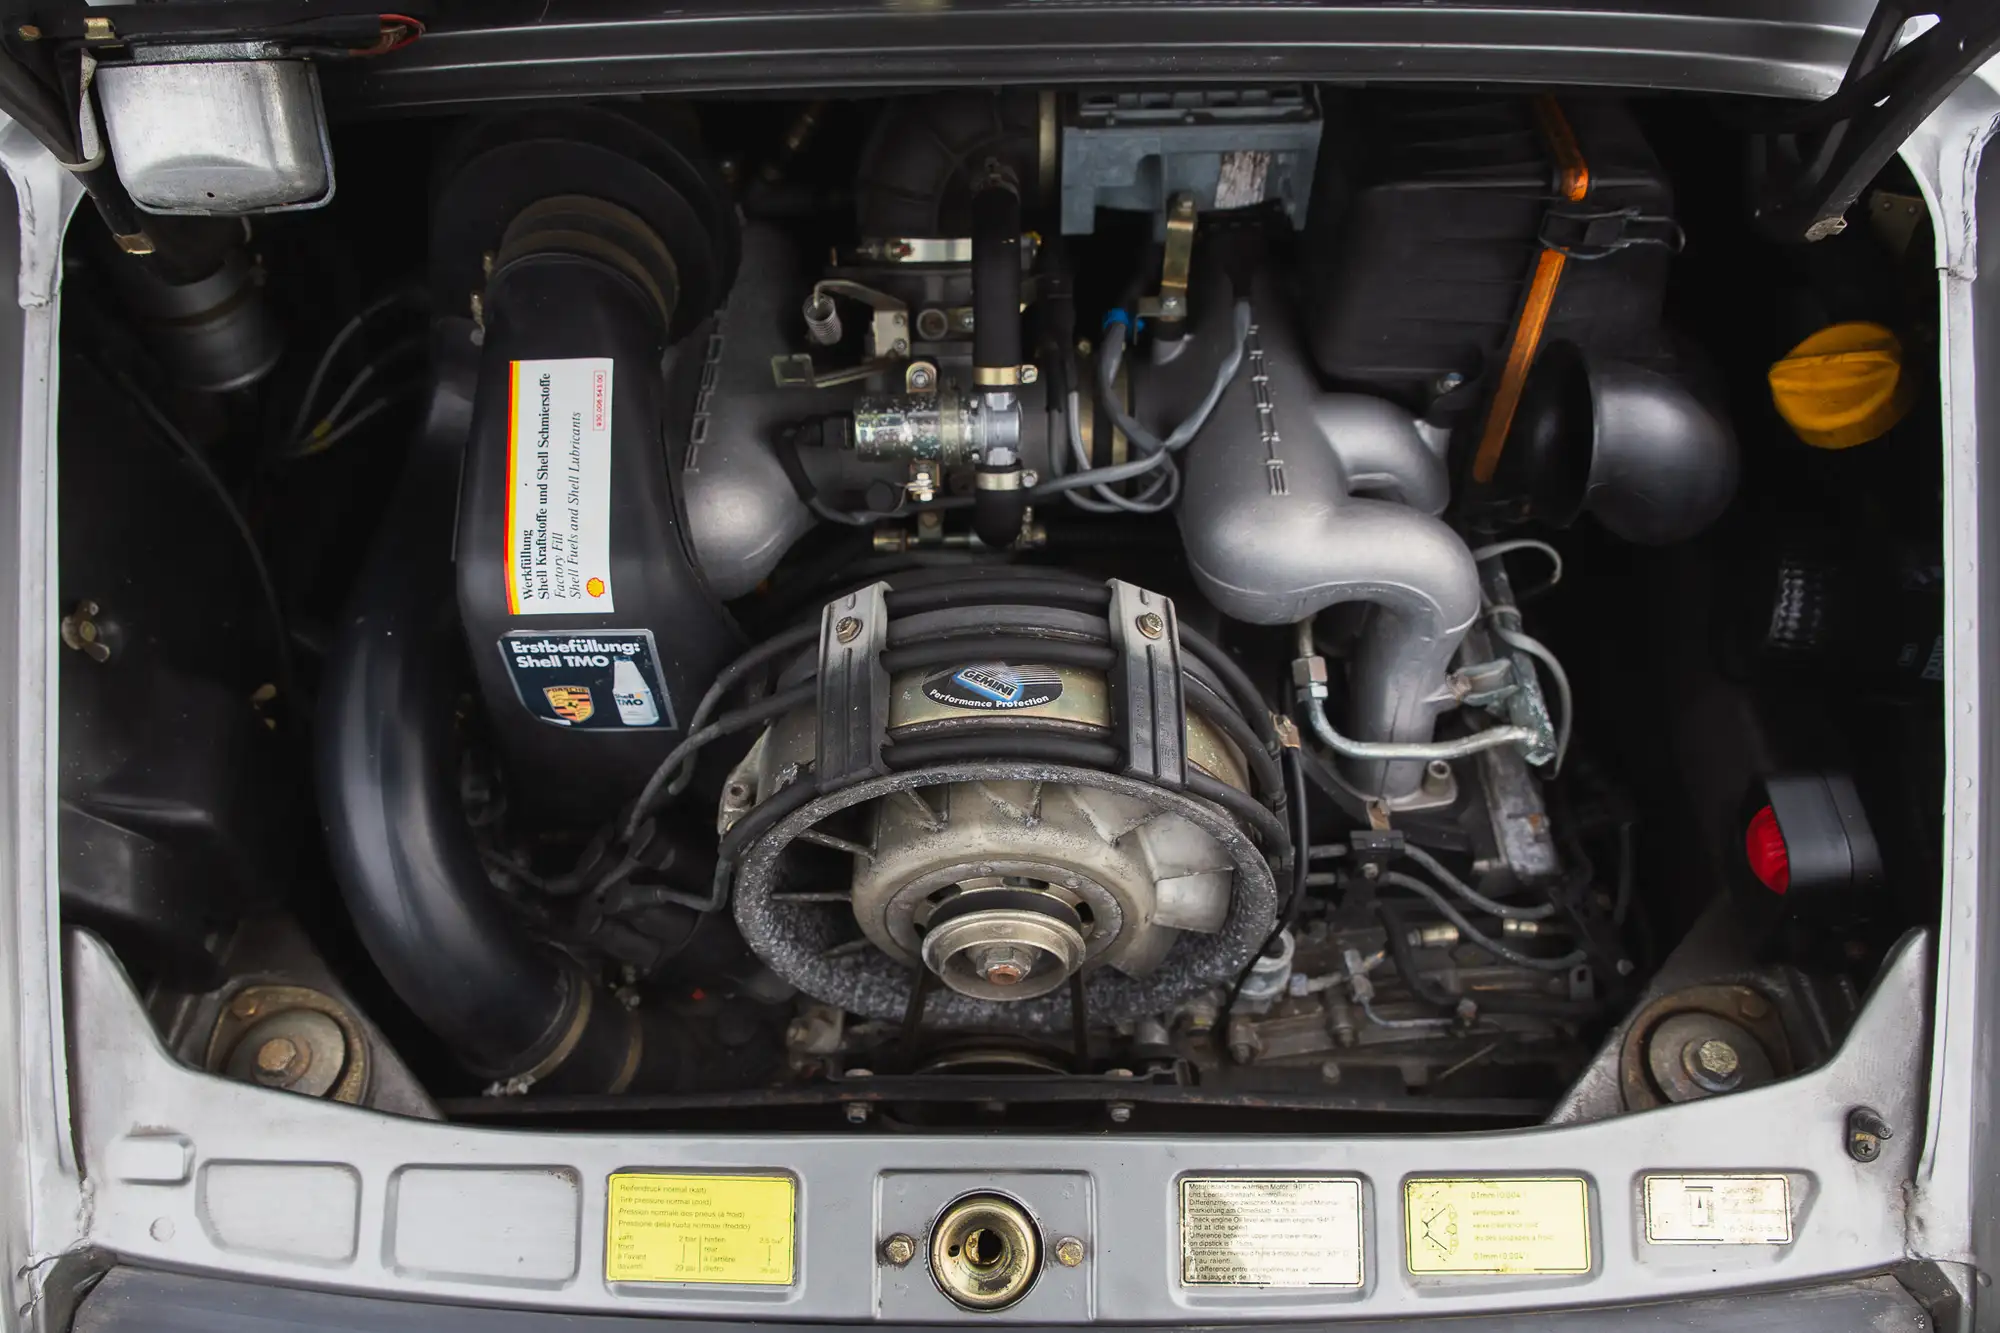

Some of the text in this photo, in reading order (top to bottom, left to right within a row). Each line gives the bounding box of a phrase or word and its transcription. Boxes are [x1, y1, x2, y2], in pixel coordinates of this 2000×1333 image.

[536, 373, 551, 599] Shell Kraftstoffe und Shell Schmierstoffe
[567, 412, 581, 599] Shell Fuels and Shell Lubricants
[521, 530, 533, 599] Werkfüllung
[552, 533, 566, 599] Factory Fill
[511, 640, 640, 655] Erstbefüllung:
[517, 655, 609, 668] Shell TMO
[963, 669, 1015, 697] GEMINI
[930, 689, 1049, 708] Performance Protection
[663, 1185, 688, 1193] normal
[618, 1208, 649, 1216] Pression
